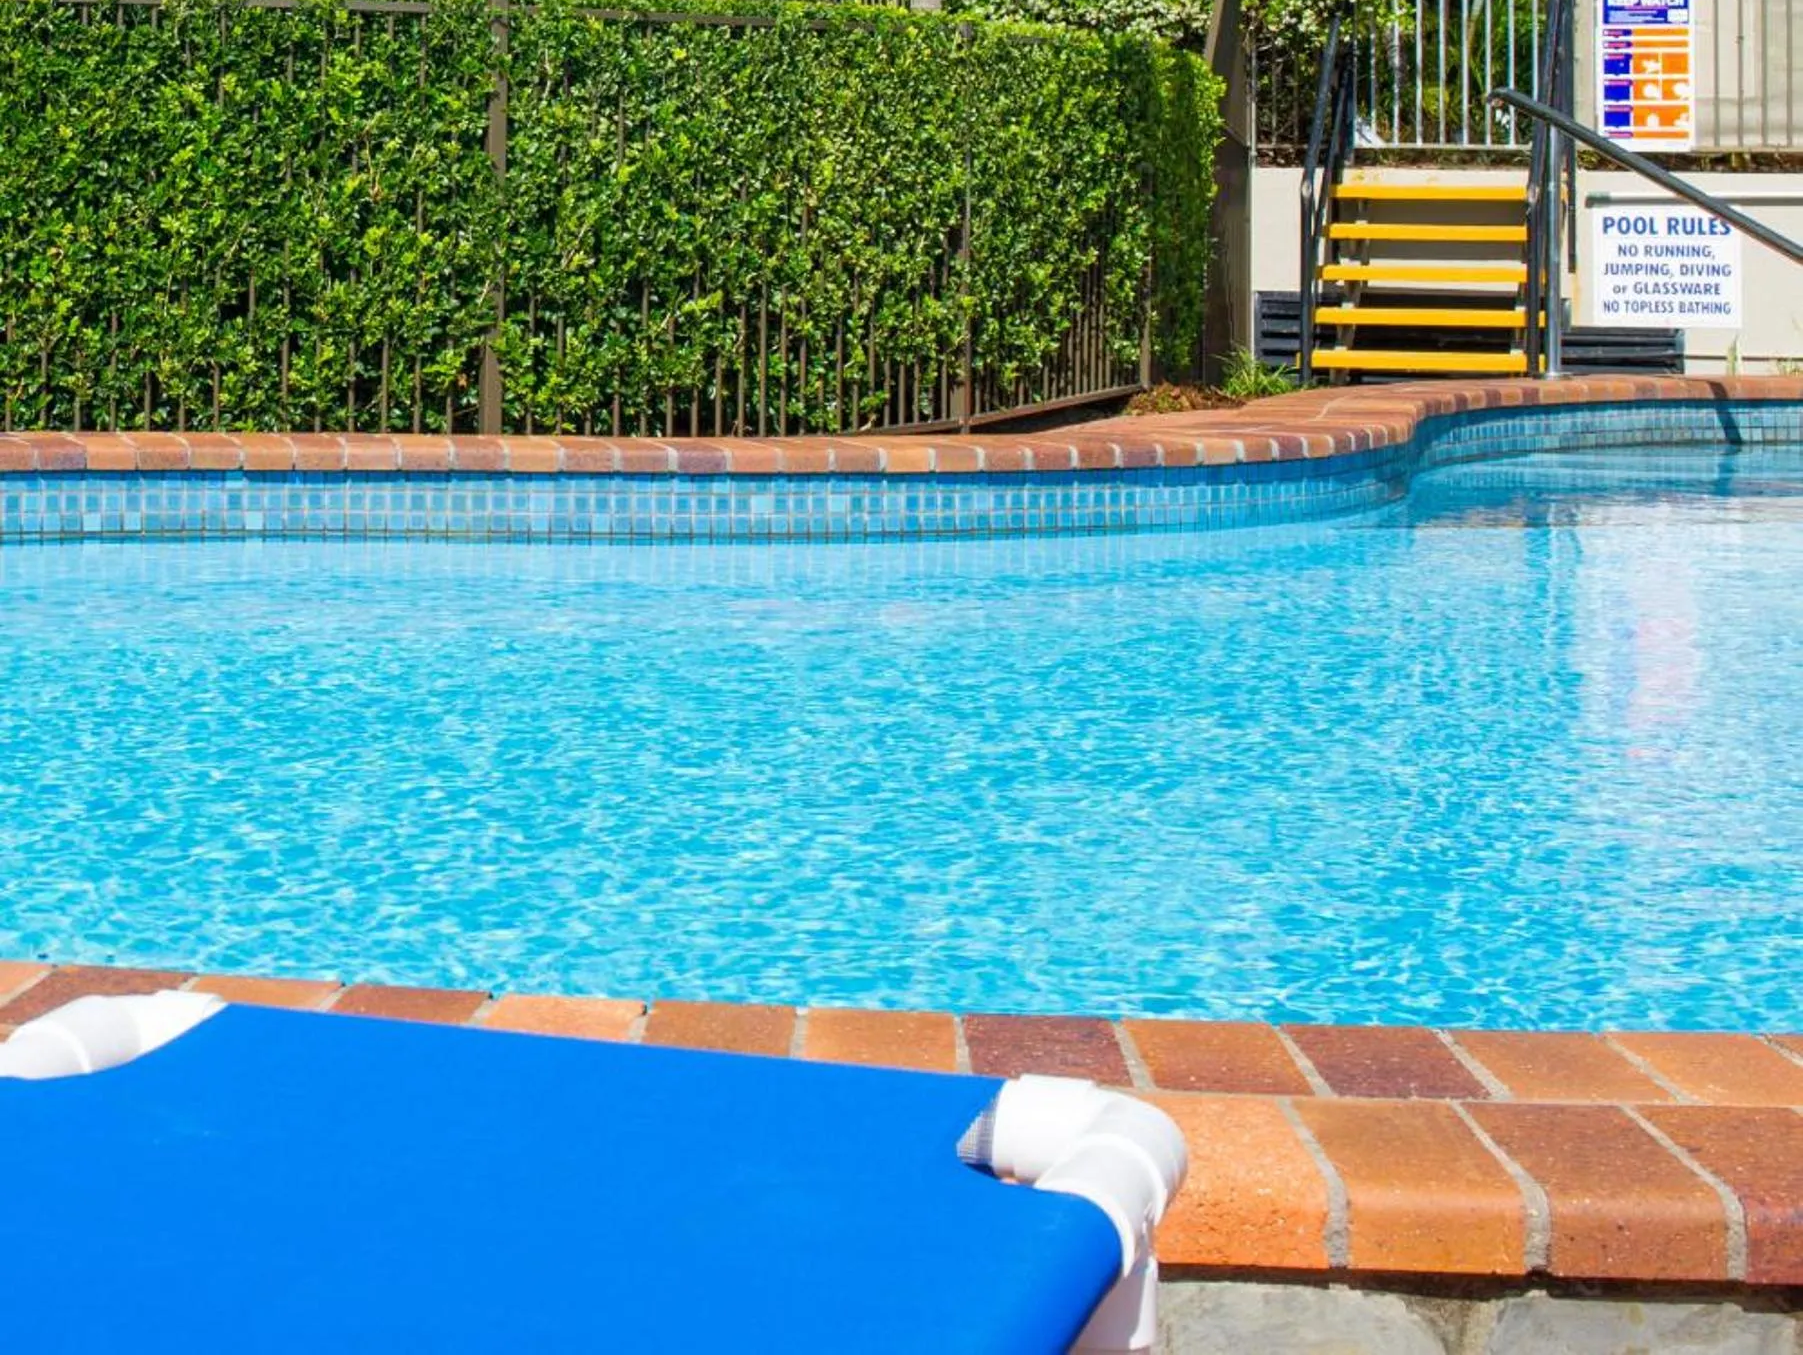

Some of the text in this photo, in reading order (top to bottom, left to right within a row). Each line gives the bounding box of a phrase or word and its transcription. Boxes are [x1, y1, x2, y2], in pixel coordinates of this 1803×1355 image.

[1603, 216, 1732, 236] POOL RULES
[1617, 244, 1716, 260] NO RUNNING,
[1603, 263, 1732, 279] JUMPING, DIVING
[1612, 282, 1721, 295] or GLASSWARE
[1603, 300, 1732, 315] NO TOPLESS BATHING
